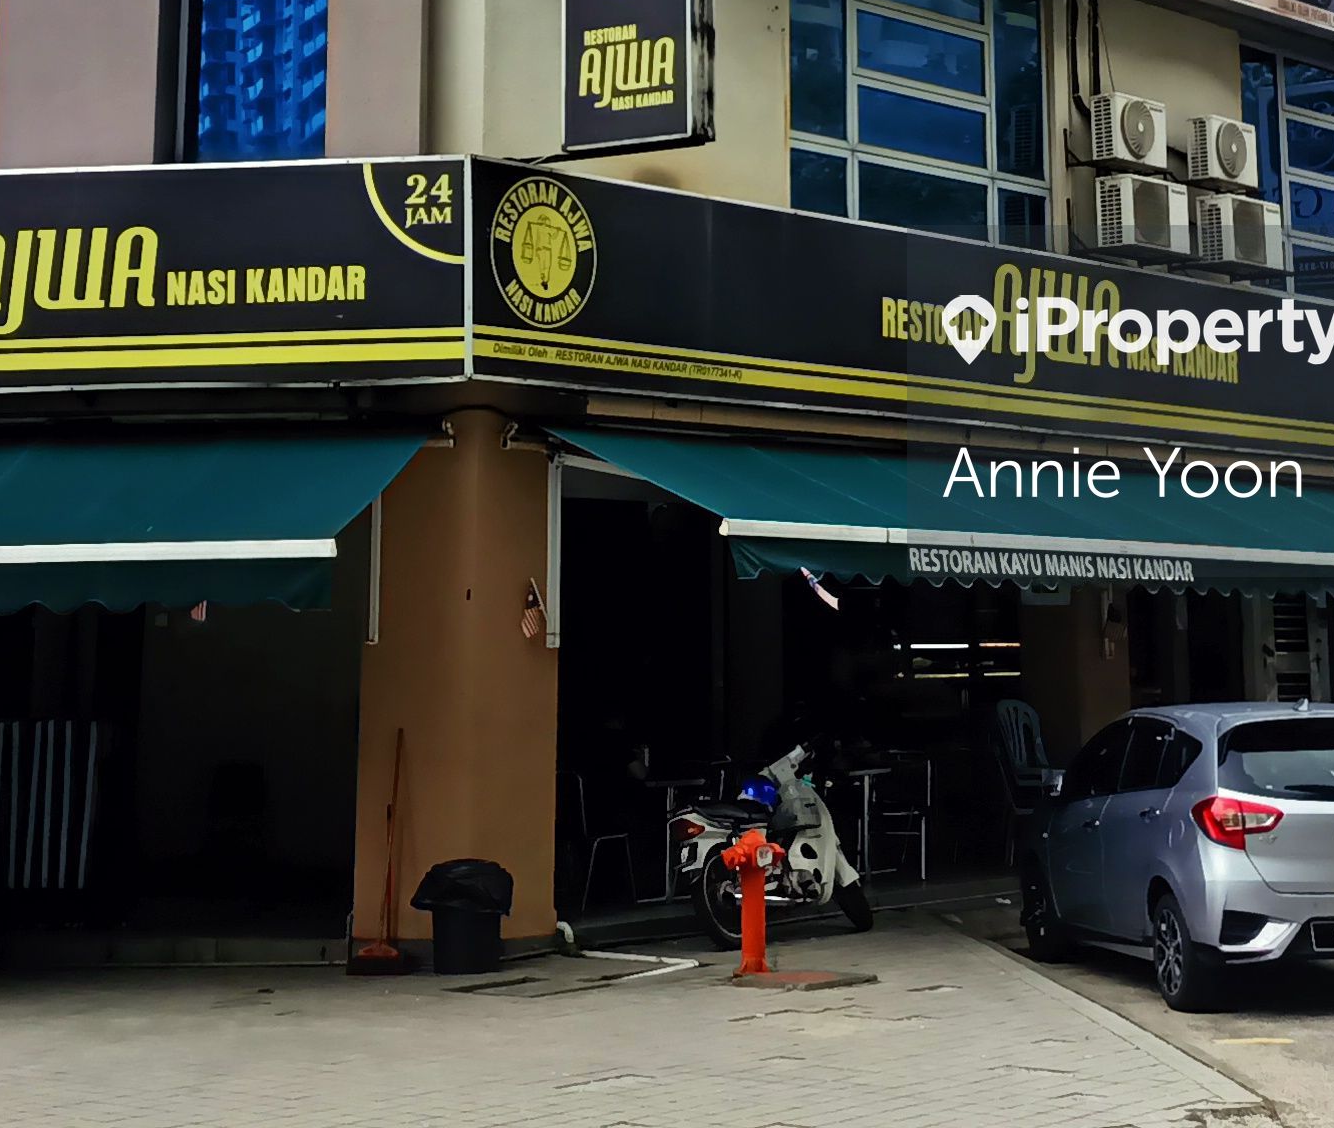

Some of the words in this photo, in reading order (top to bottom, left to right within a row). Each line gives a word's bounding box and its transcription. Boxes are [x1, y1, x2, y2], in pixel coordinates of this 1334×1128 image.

[584, 24, 637, 46] RESTORAN
[579, 36, 674, 108] AJWA
[611, 95, 634, 111] NASI
[636, 90, 674, 108] KANDAR
[404, 174, 453, 205] 24
[404, 206, 453, 229] JAM
[495, 182, 559, 243] RESTORAN
[560, 195, 593, 252] AJWA
[166, 270, 236, 306] NASI
[246, 265, 366, 304] KANDAR
[505, 279, 533, 315] NASI
[534, 287, 582, 323] KANDAR
[528, 347, 548, 358] Oleh
[555, 351, 603, 364] RESTORAN
[605, 355, 629, 367] AJWA
[631, 358, 651, 369] NASI
[652, 360, 688, 372] KANDAR
[909, 548, 998, 574] RESTORAN
[999, 552, 1042, 576] KAYU
[1044, 553, 1099, 578] MANIS
[1097, 556, 1132, 579] NASI
[1133, 558, 1194, 582] KANDAR
